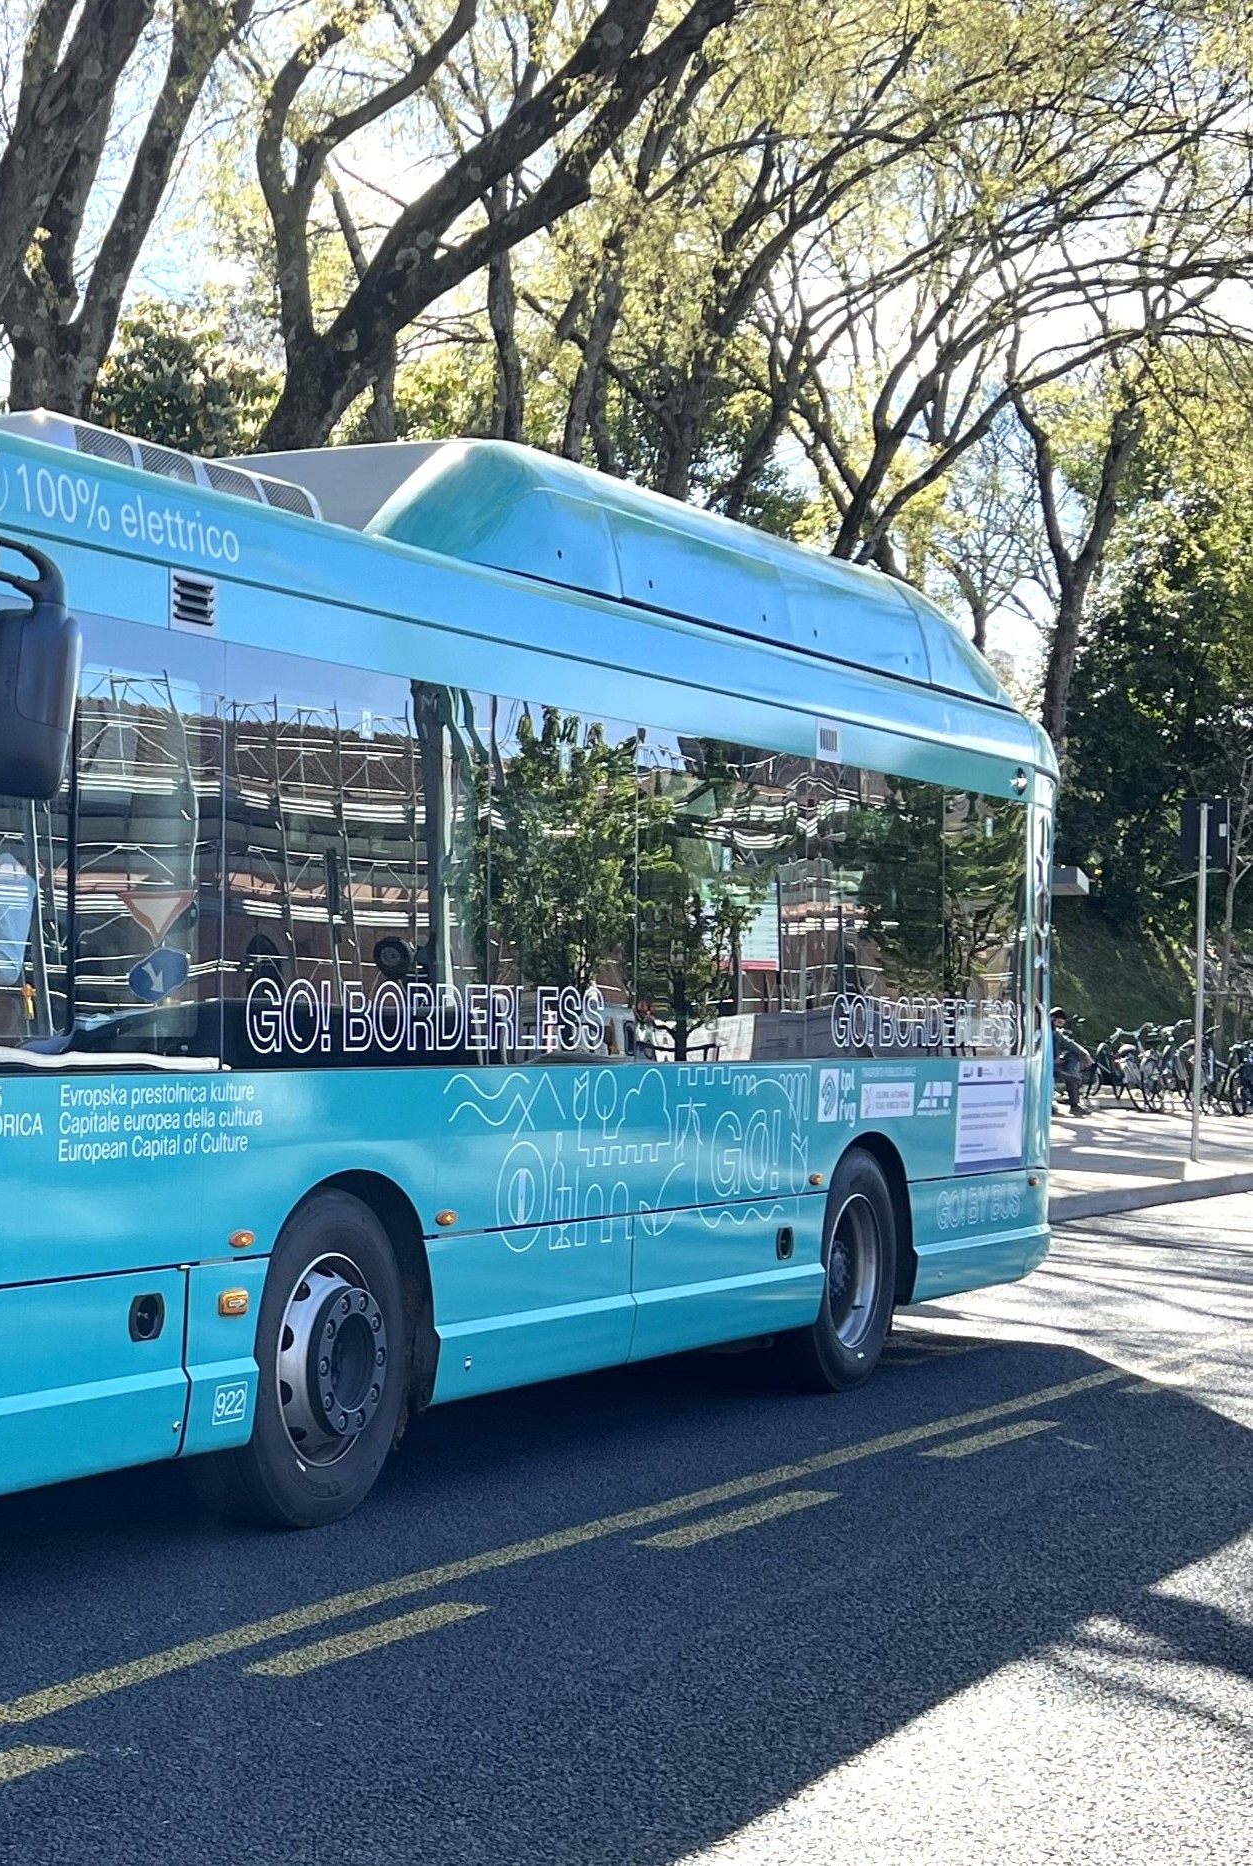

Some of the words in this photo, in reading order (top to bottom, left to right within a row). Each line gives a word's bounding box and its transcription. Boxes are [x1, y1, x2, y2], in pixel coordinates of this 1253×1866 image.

[16, 463, 111, 532] 100%
[120, 495, 239, 563] elettrico
[246, 977, 331, 1054] GO!
[342, 980, 605, 1052] BORDERLESS
[831, 993, 874, 1048] GO!
[879, 995, 1017, 1048] BORDERLESS
[60, 1083, 127, 1110] Evropska
[131, 1082, 207, 1109] prestolnica
[210, 1081, 255, 1102] kulture
[59, 1111, 120, 1138] Capitale
[123, 1114, 180, 1134] europea
[184, 1108, 215, 1128] della
[219, 1106, 263, 1127] cultura
[58, 1138, 127, 1165] European
[131, 1134, 181, 1160] Capital
[183, 1133, 198, 1154] of
[201, 1131, 248, 1154] Culture
[710, 1109, 782, 1199] GO!
[216, 1387, 245, 1417] 922
